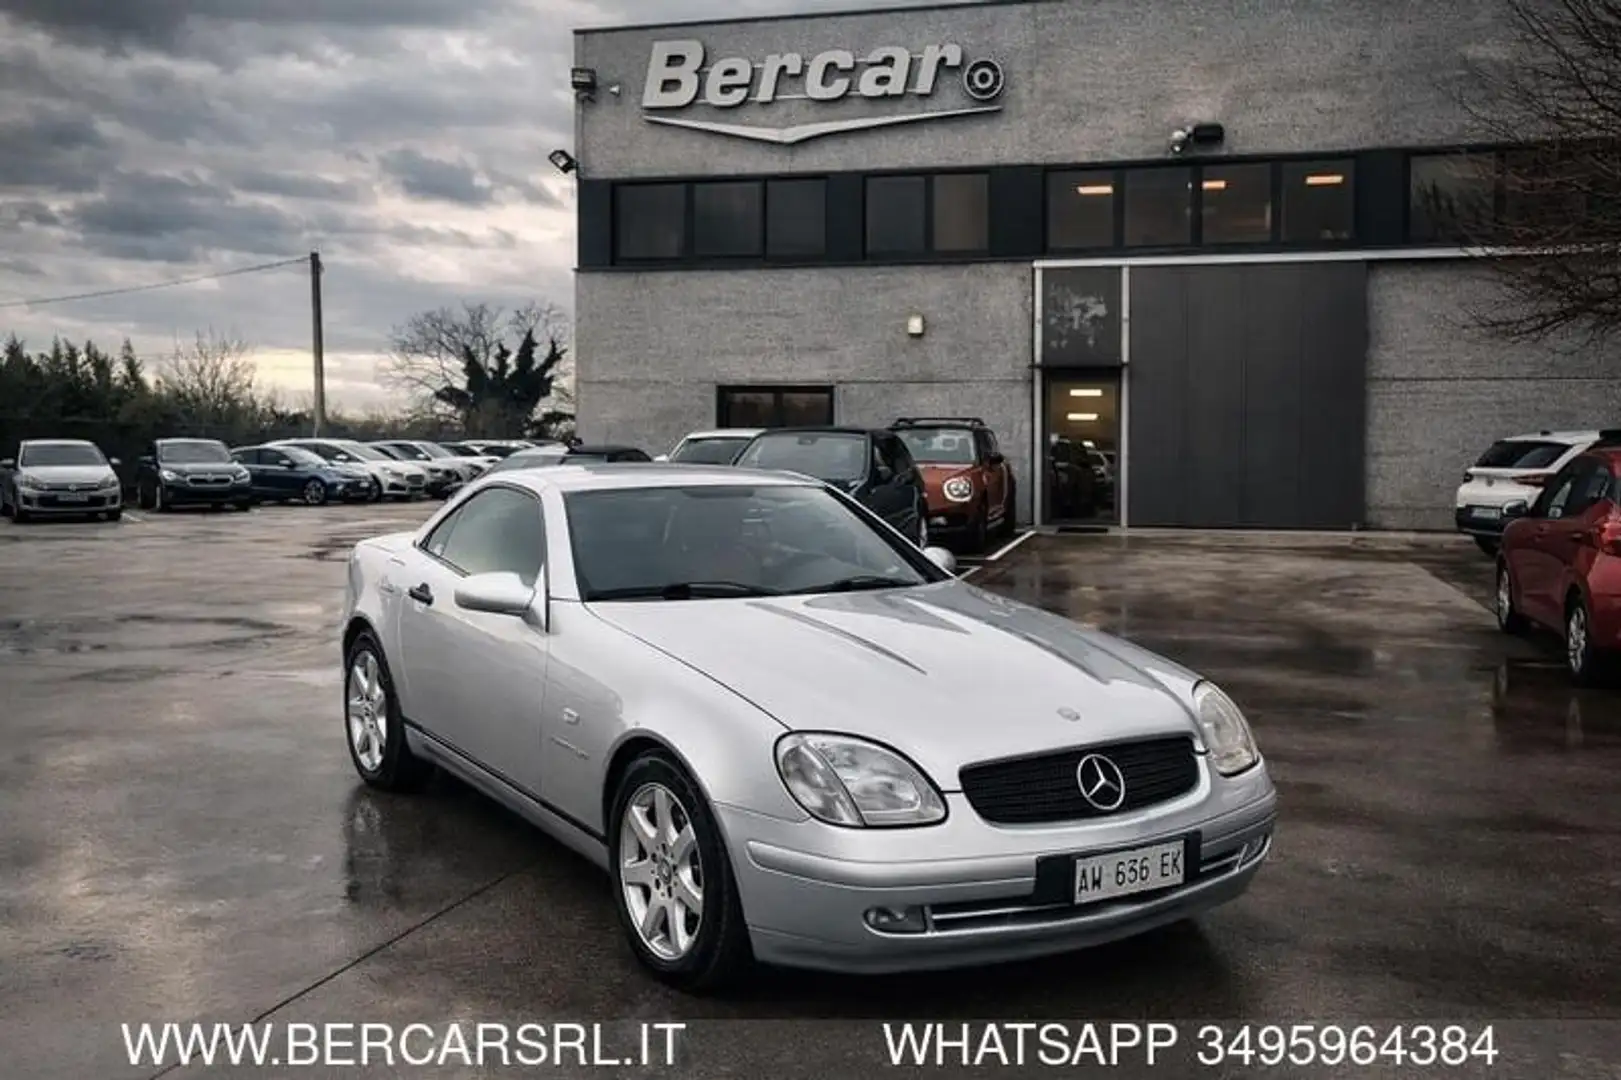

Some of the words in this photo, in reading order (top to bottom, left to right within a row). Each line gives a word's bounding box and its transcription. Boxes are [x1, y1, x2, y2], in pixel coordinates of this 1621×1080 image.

[642, 40, 962, 108] Bercar
[1116, 857, 1150, 886] 636
[1161, 850, 1181, 877] EK
